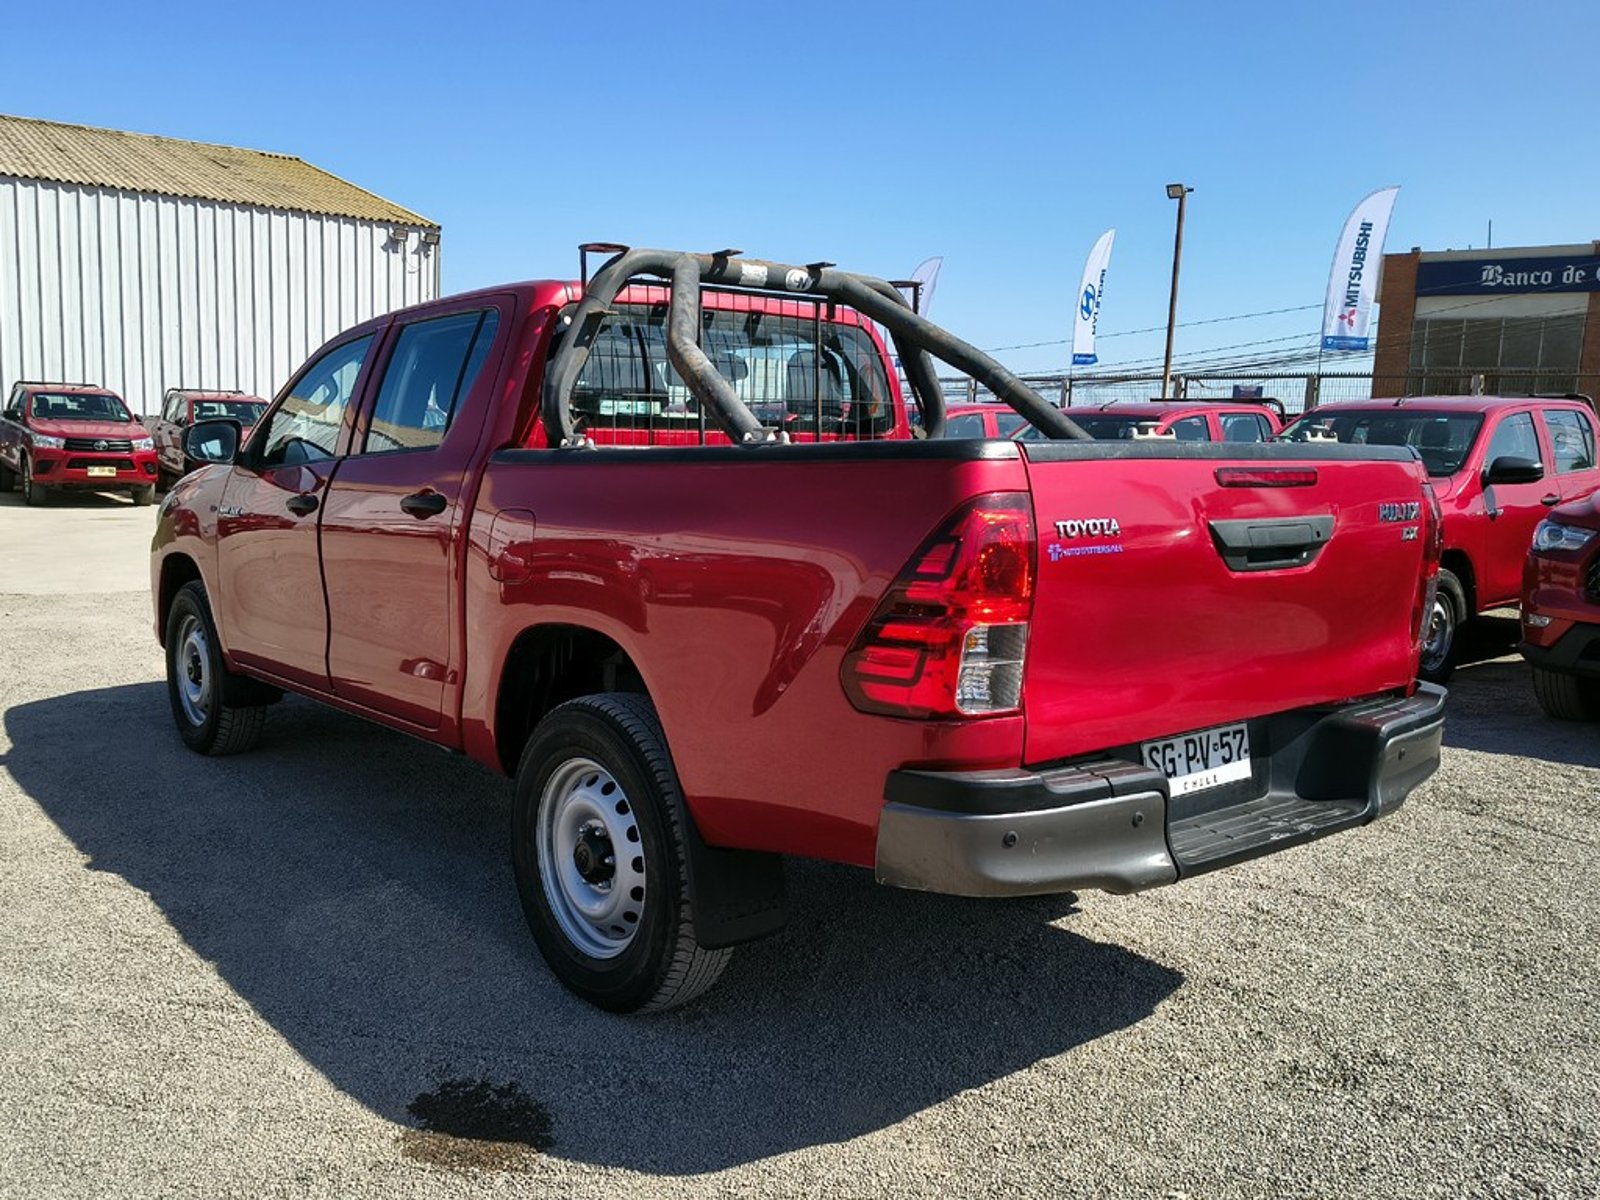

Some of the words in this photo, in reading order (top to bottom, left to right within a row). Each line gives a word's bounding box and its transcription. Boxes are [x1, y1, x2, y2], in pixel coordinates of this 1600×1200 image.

[1345, 221, 1373, 308] MITSUBISHI
[1481, 264, 1552, 287] Banco
[1562, 265, 1586, 284] de
[1055, 518, 1121, 538] TOYOTA
